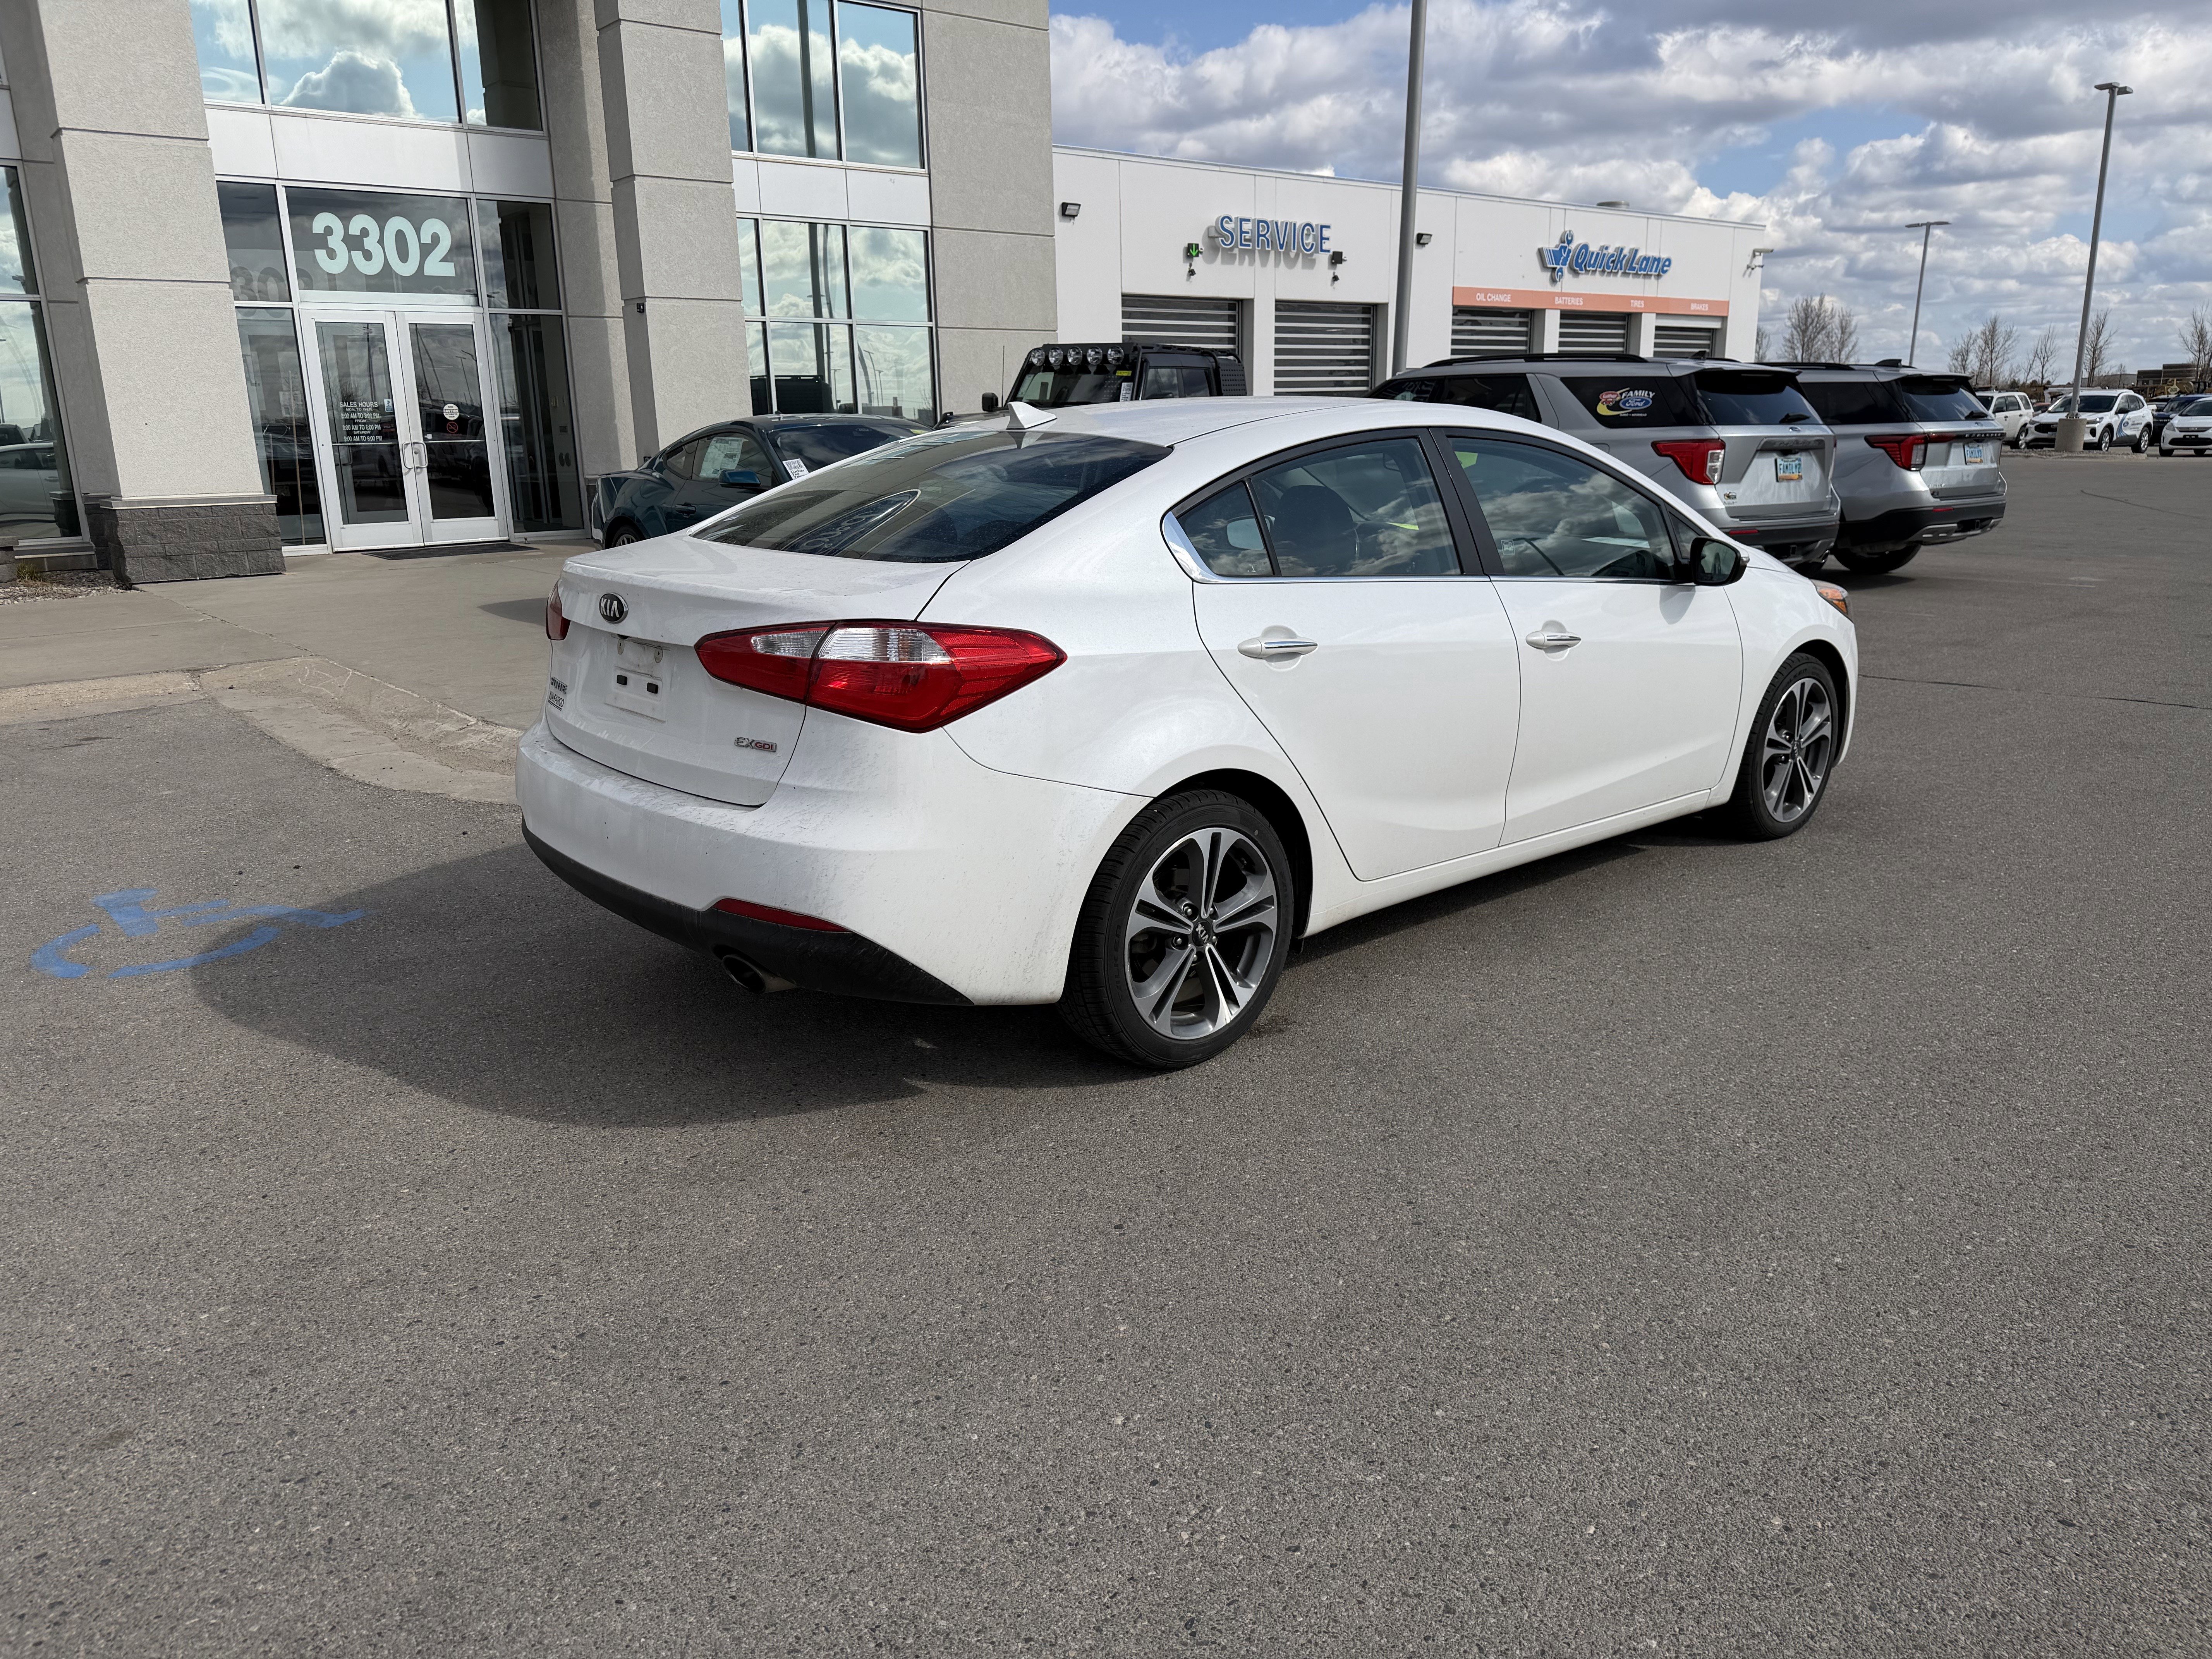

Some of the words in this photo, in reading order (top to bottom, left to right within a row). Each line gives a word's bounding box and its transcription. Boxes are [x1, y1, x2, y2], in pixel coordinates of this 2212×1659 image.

[1218, 214, 1332, 254] SERVICE
[312, 212, 456, 277] 3302
[1476, 293, 1486, 302] OIL
[1487, 293, 1511, 302] CHANGE
[1554, 296, 1583, 306] BATTERIES
[1630, 300, 1645, 308] TIRES
[1621, 390, 1656, 399] FAMILY
[1626, 398, 1645, 406] Ford
[1779, 463, 1801, 474] FAMILY2
[601, 598, 620, 618] KIA
[734, 737, 755, 749] EX
[755, 742, 773, 750] GDI
[1195, 923, 1209, 944] KIA
